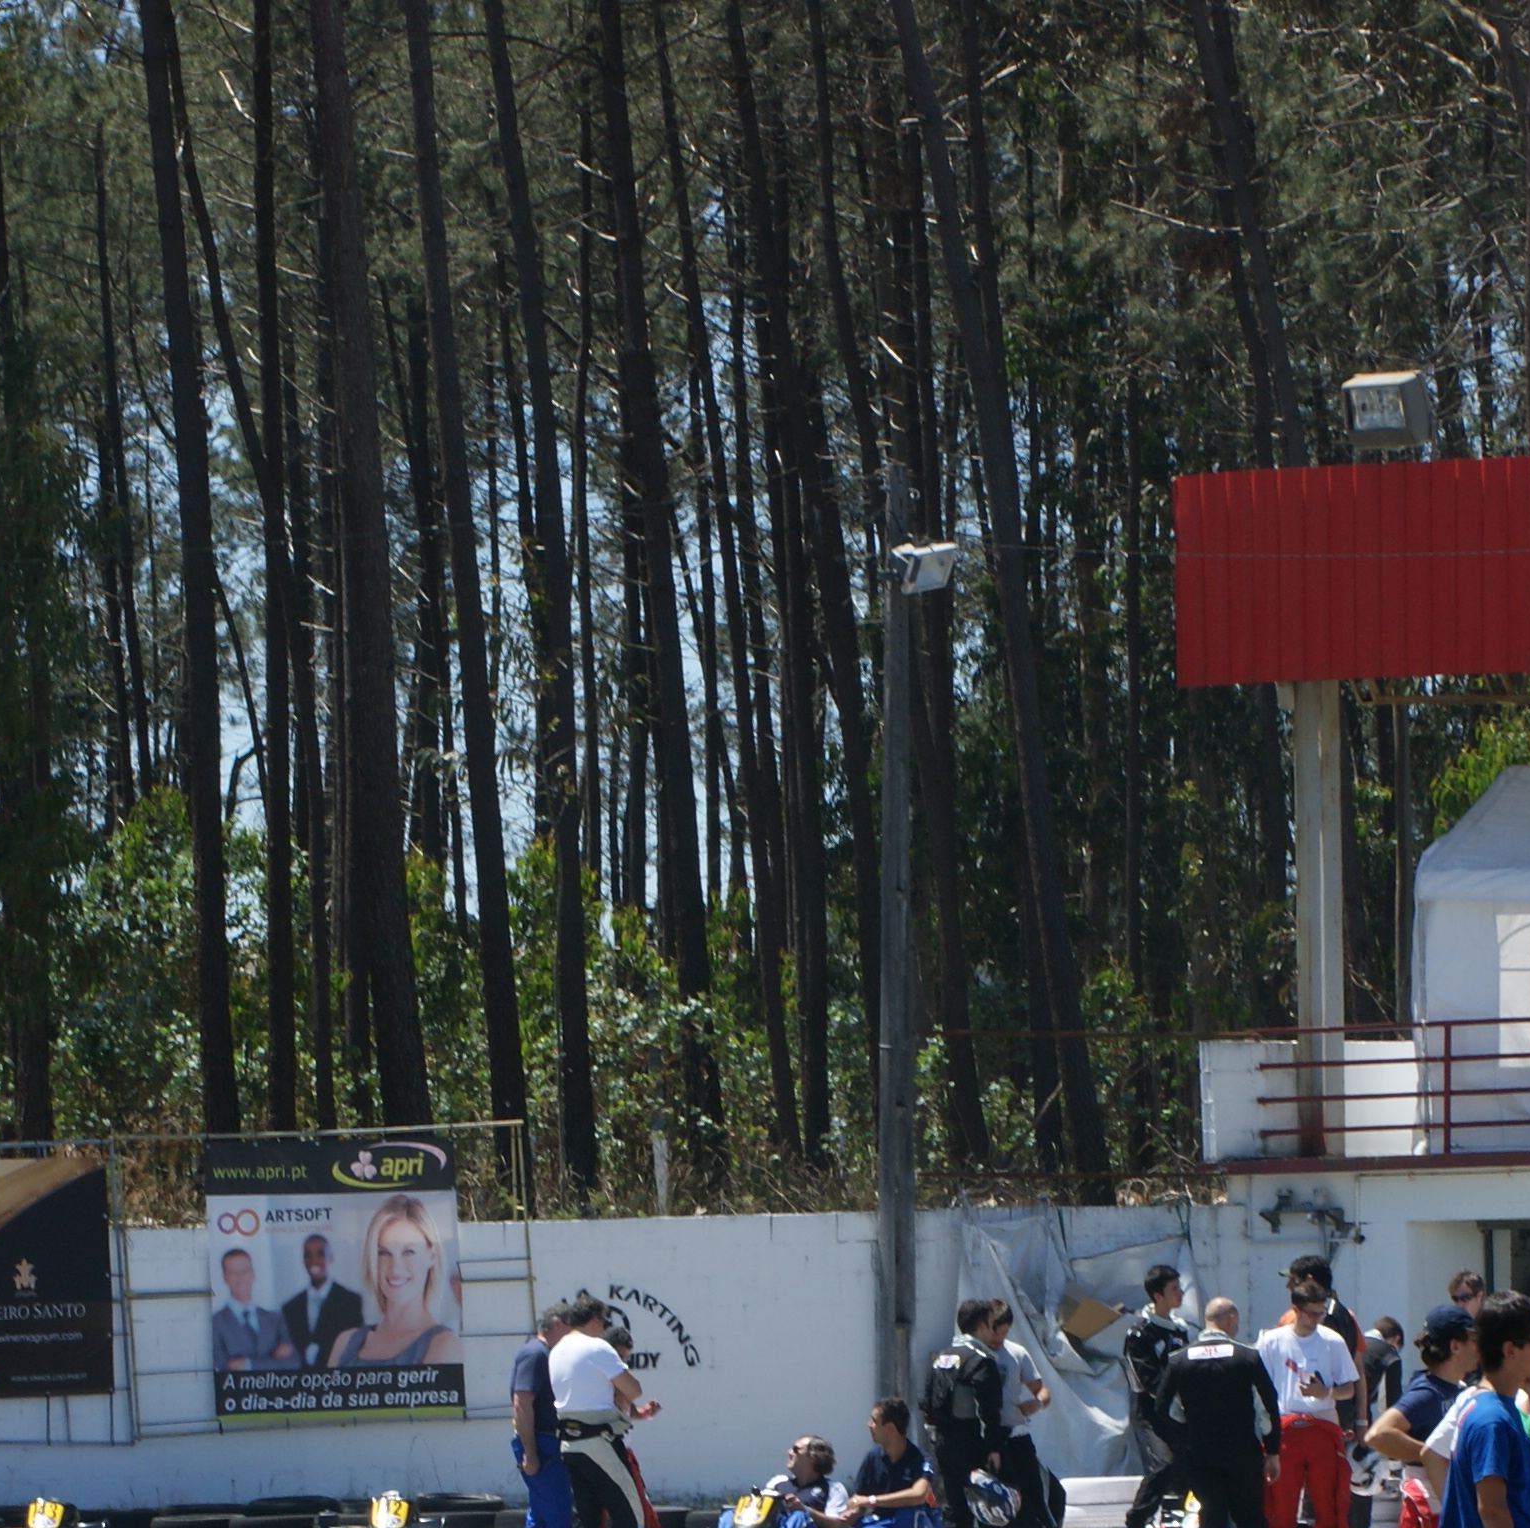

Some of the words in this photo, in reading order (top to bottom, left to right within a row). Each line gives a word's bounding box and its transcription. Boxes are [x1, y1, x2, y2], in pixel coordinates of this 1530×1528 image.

[212, 1164, 308, 1181] www.apri.pt
[380, 1151, 425, 1181] apri
[265, 1207, 333, 1223] ARTSOFT
[32, 1302, 87, 1319] SANTO
[608, 1284, 701, 1368] KARTING
[222, 1374, 236, 1391] A
[239, 1371, 297, 1390] melhor
[301, 1369, 351, 1391] opção
[355, 1371, 393, 1389] para
[397, 1366, 439, 1388] gerir
[225, 1398, 236, 1412] o
[241, 1391, 317, 1411] dia-a-dia
[321, 1389, 344, 1409] da
[348, 1392, 380, 1407] sua
[384, 1389, 460, 1408] empresa
